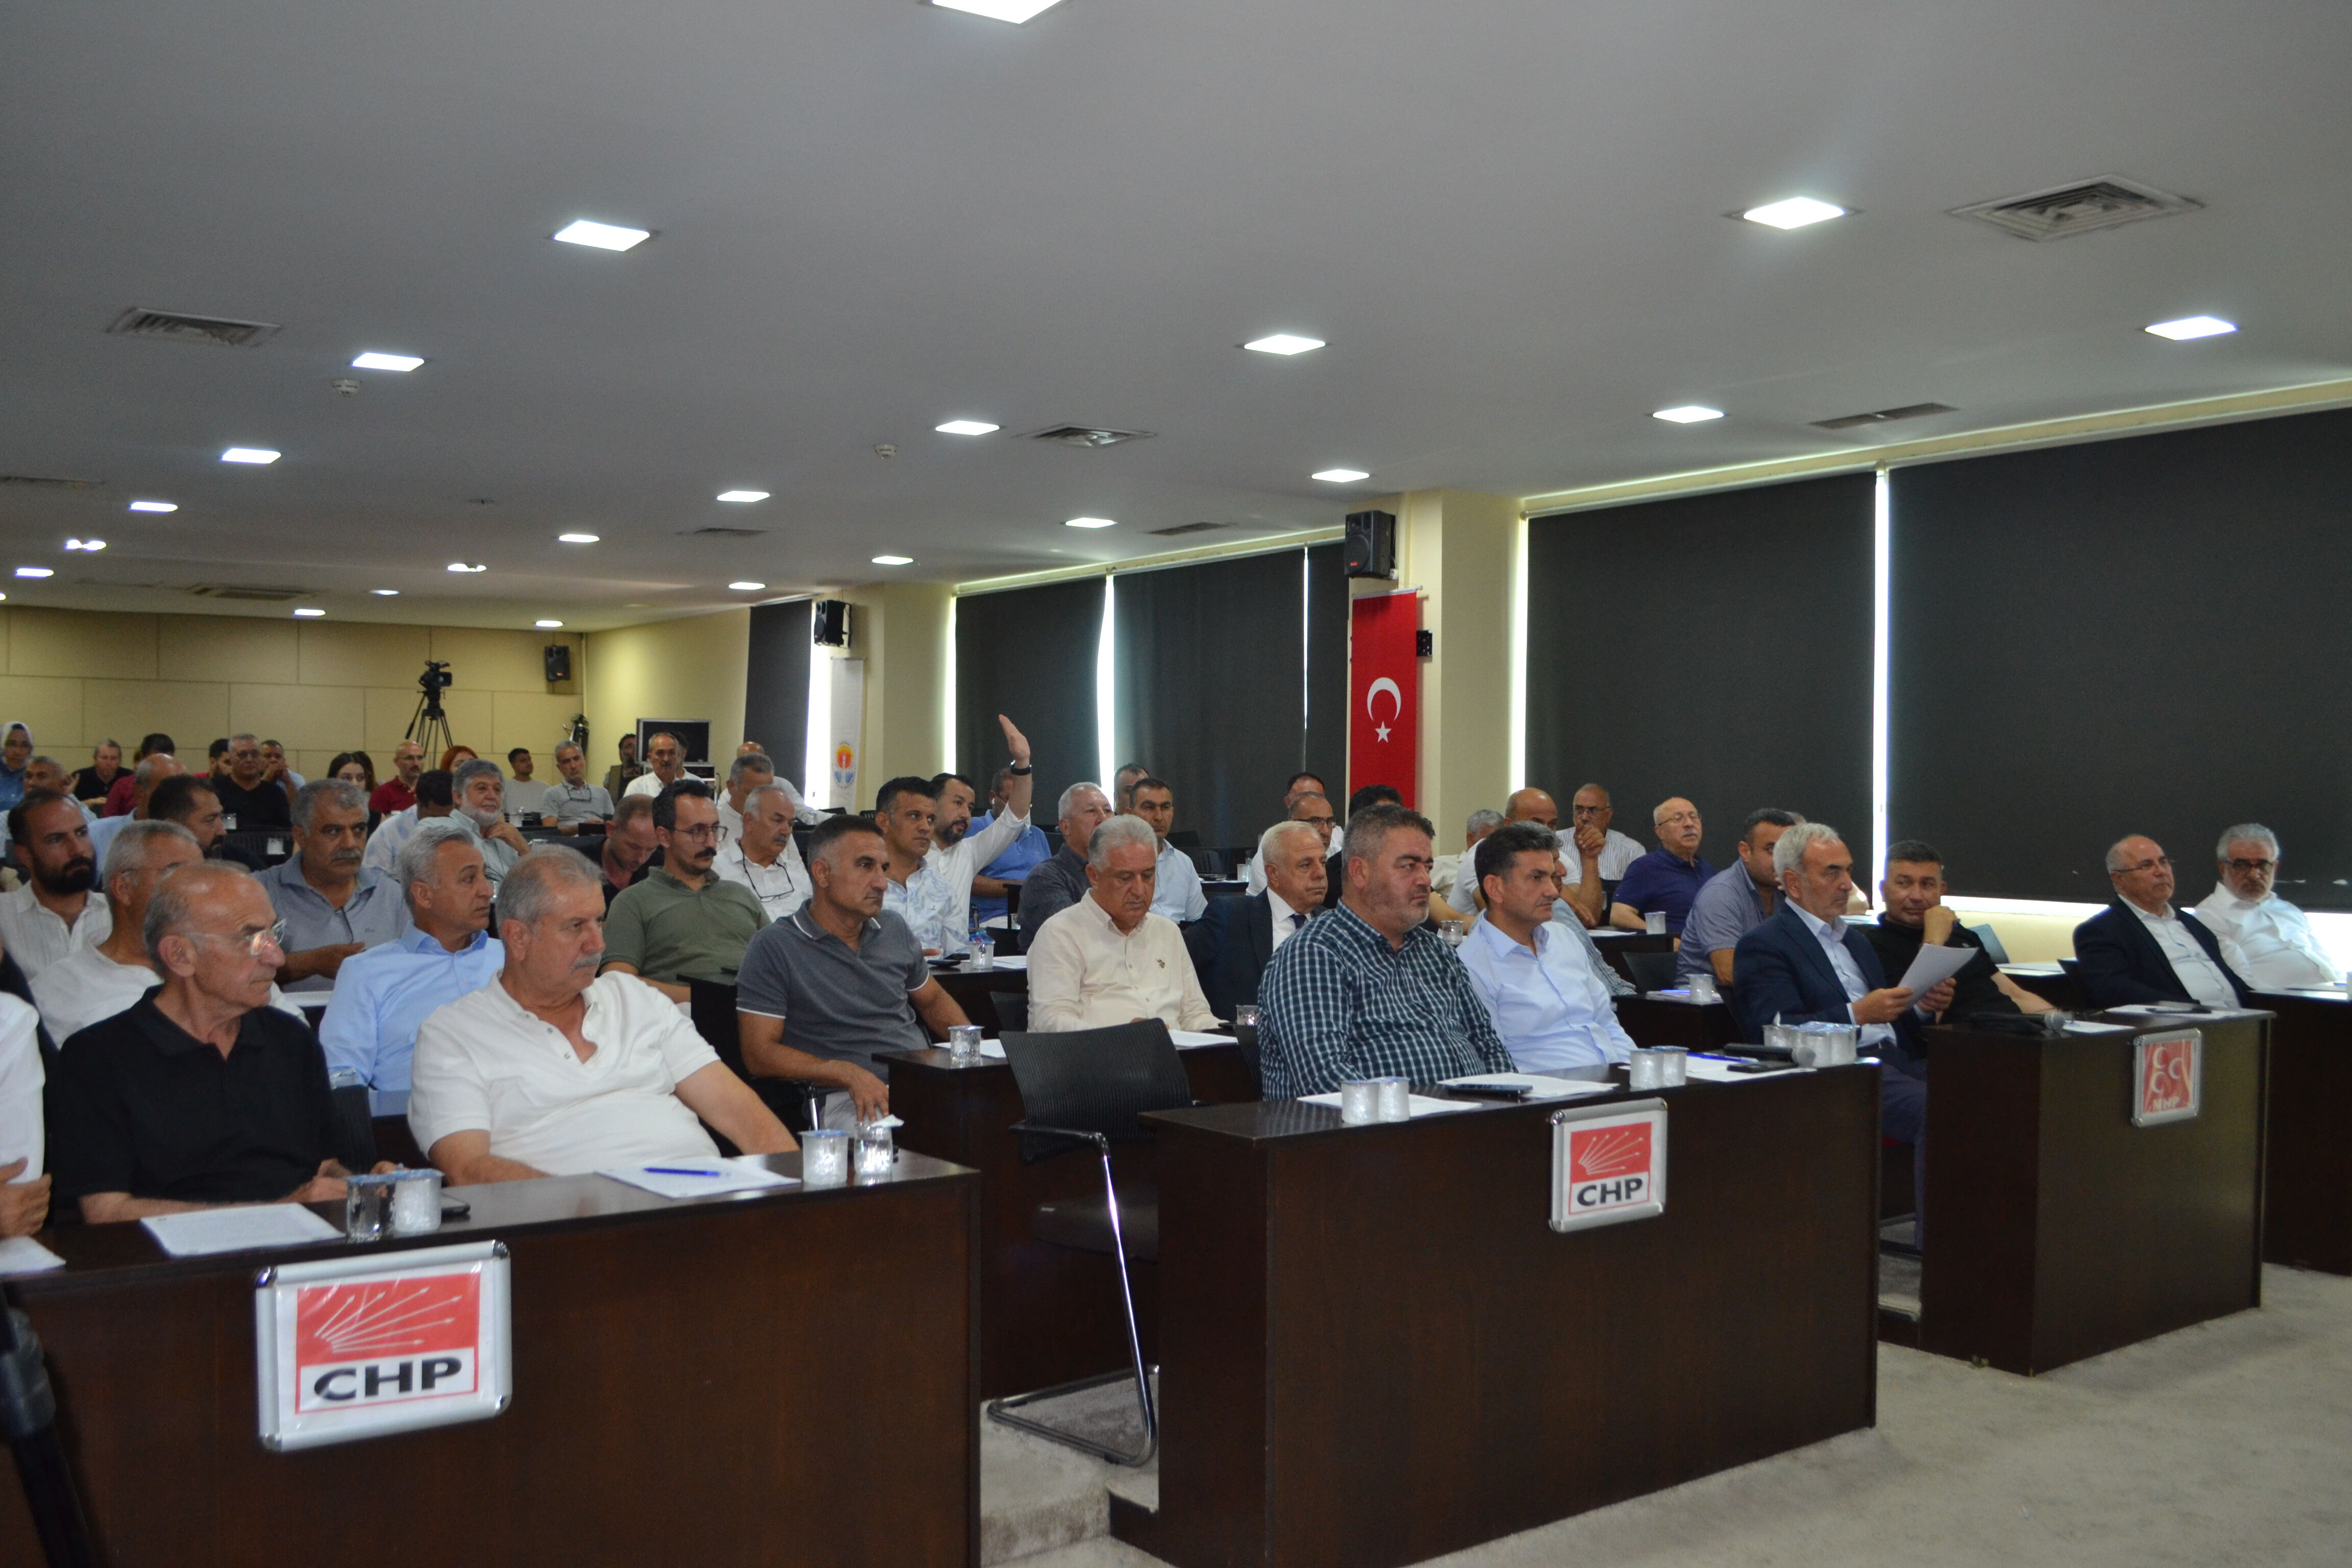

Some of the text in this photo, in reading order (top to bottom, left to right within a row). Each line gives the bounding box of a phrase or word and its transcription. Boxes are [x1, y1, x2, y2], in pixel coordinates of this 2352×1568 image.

[2153, 1096, 2179, 1111] MHP
[1577, 1178, 1643, 1206] CHP
[314, 1357, 461, 1401] CHP
